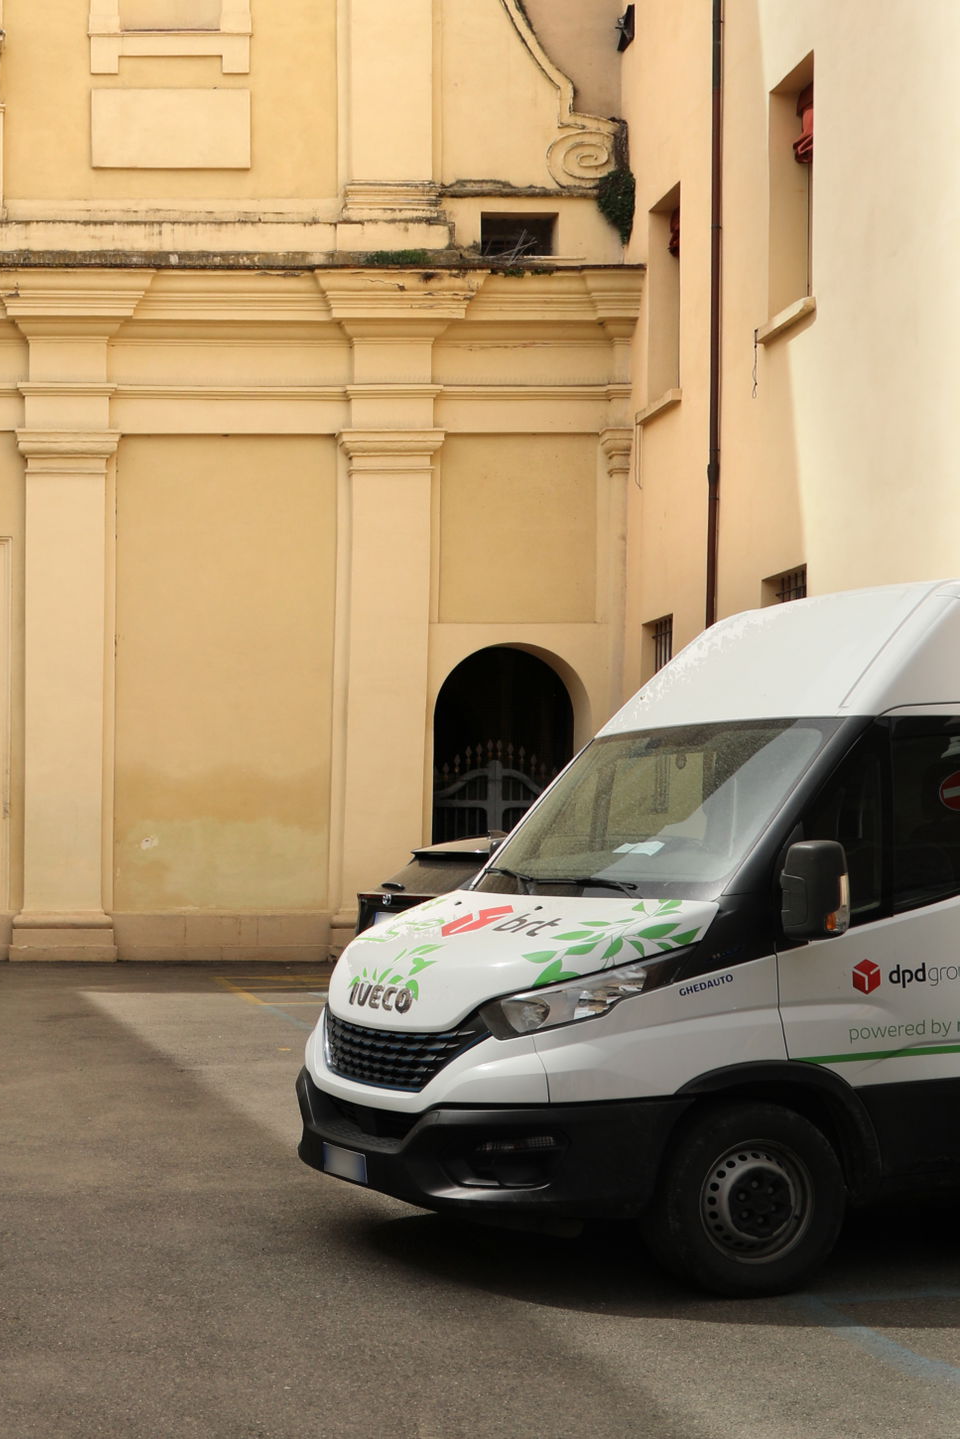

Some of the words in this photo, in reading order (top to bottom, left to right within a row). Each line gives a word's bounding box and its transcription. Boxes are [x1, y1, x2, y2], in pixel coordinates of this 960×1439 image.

[493, 913, 562, 937] brt
[679, 974, 734, 996] GHEDAUTO
[888, 962, 960, 988] dpdgro
[349, 982, 413, 1014] IVECO
[849, 1020, 926, 1044] powered
[931, 1019, 952, 1037] by
